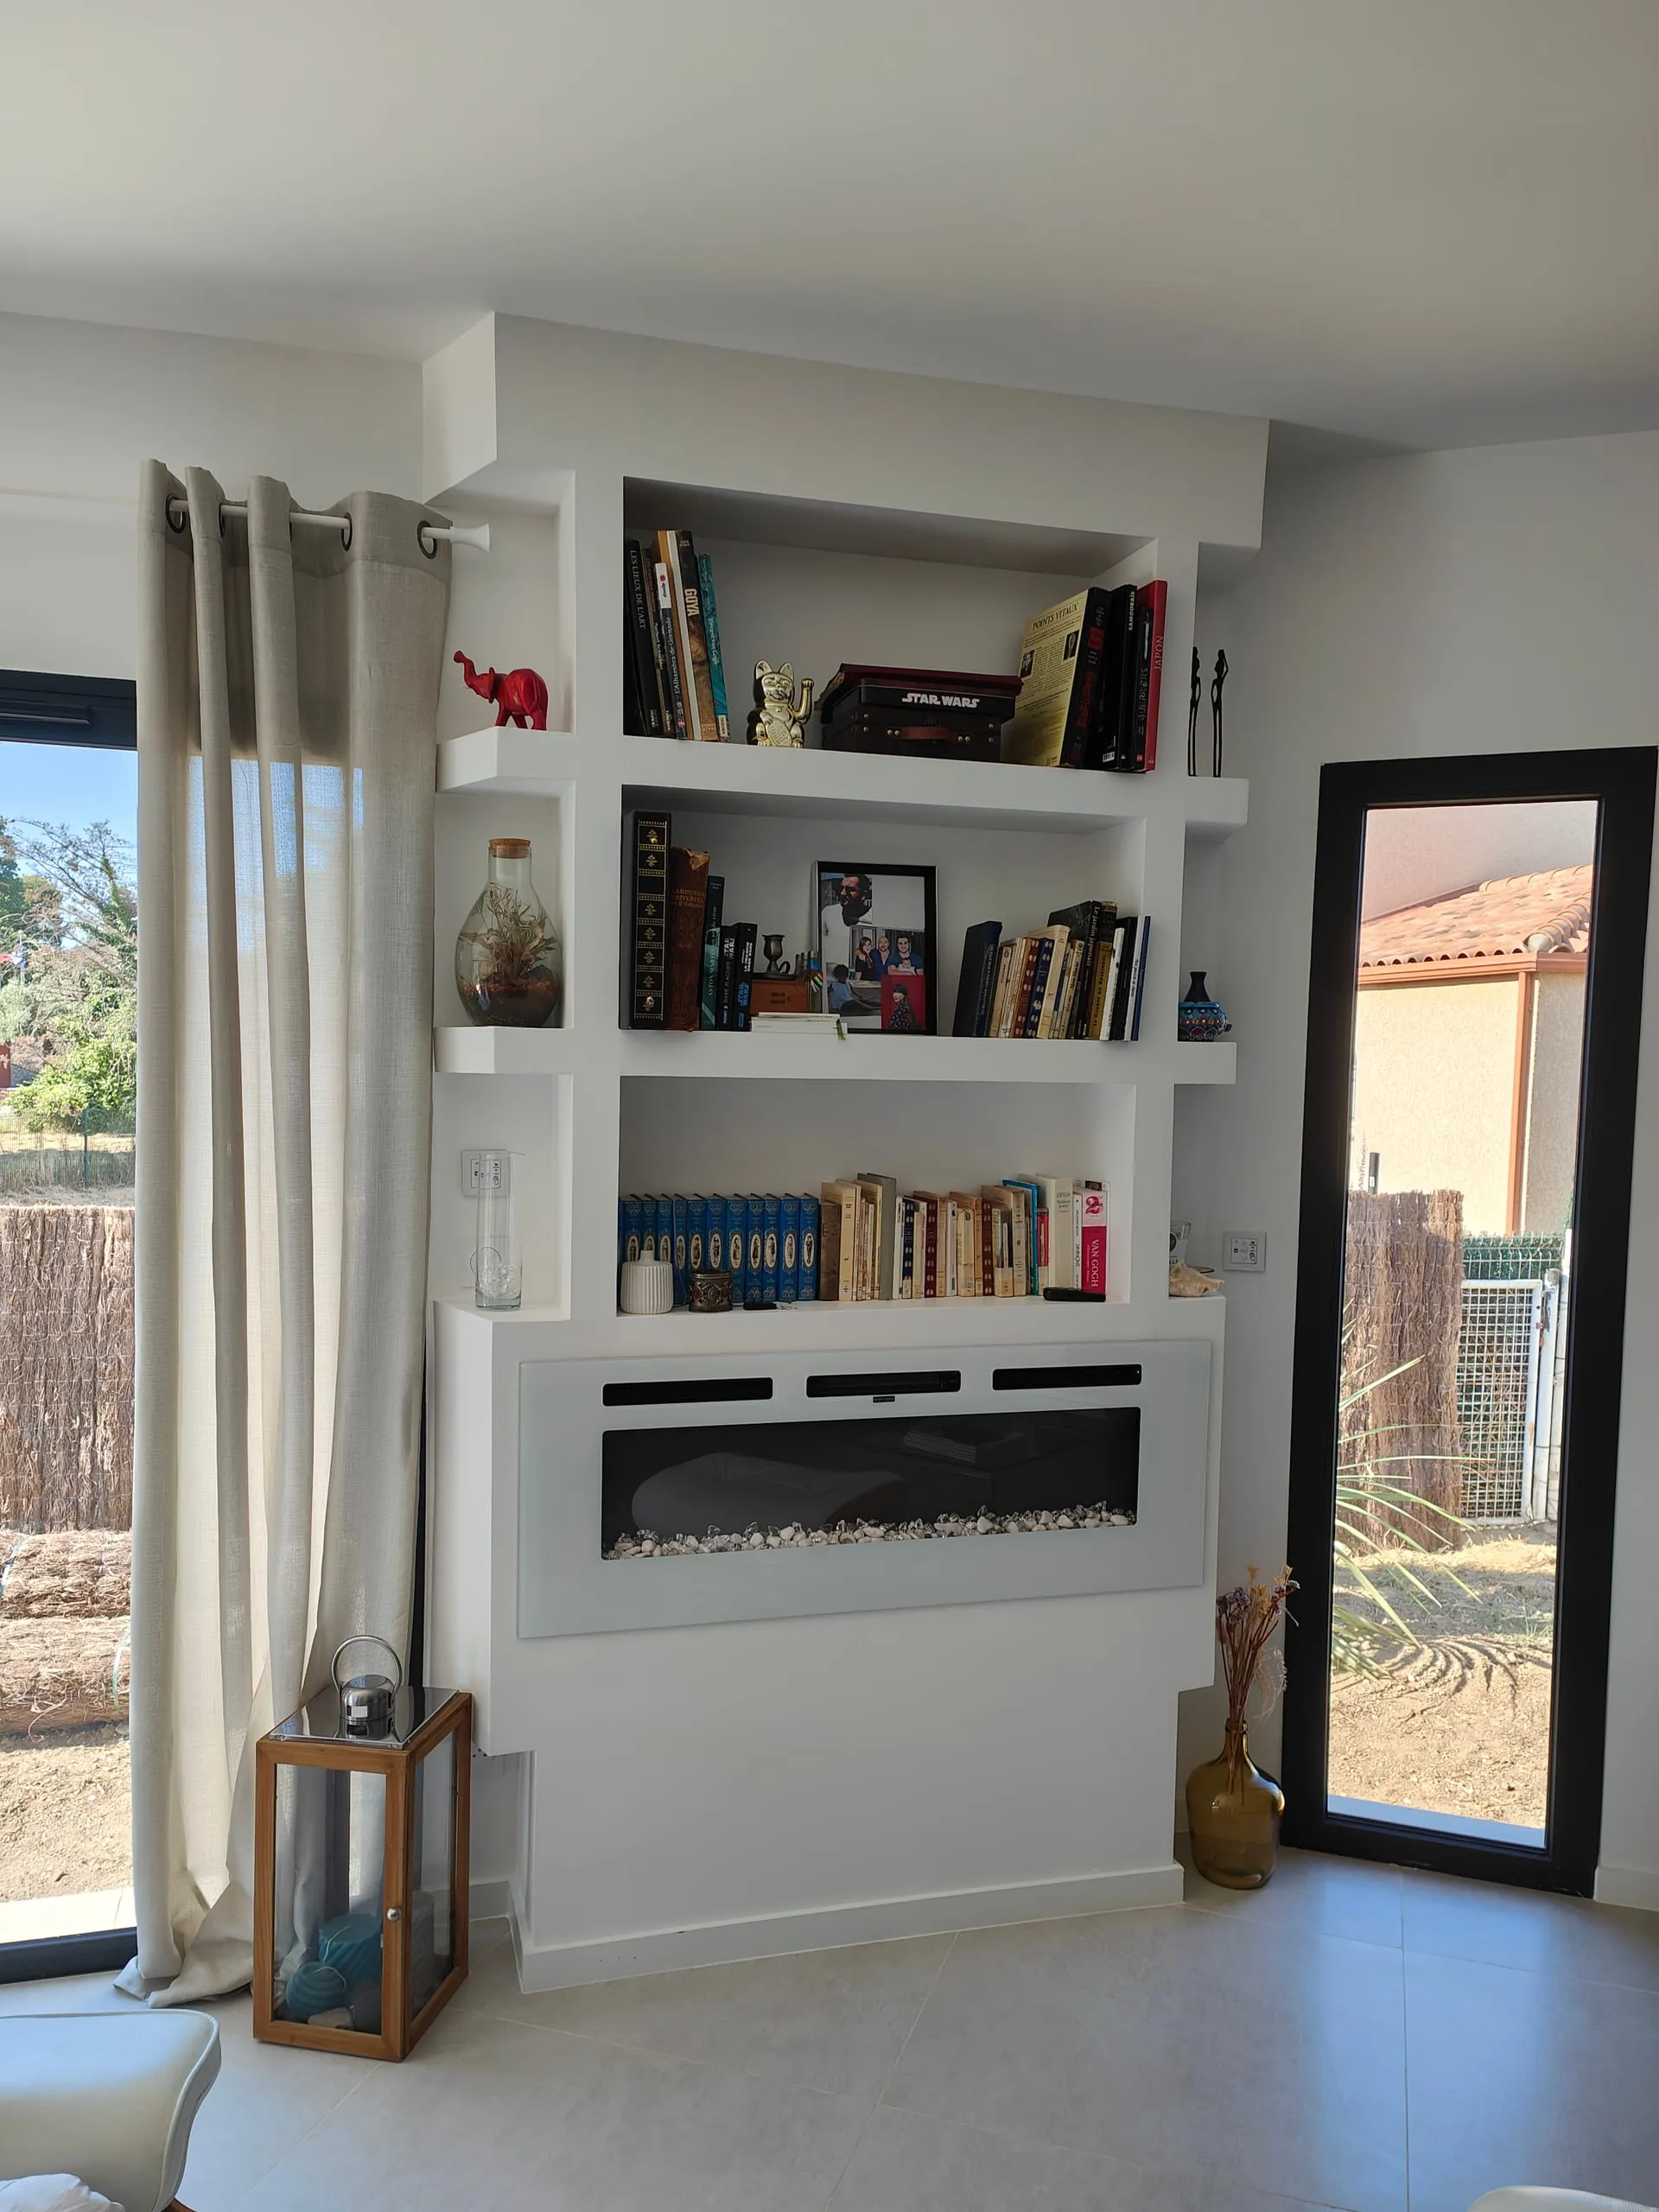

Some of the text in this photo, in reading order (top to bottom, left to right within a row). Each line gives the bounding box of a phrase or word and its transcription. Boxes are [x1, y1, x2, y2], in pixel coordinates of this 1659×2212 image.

[630, 550, 639, 564] LES
[632, 566, 642, 591] LIEUX
[635, 594, 644, 606] DE
[684, 588, 700, 616] GOYA
[1033, 614, 1054, 632] POINTS
[1054, 603, 1078, 622] VITAUX
[669, 645, 675, 655] de
[1154, 636, 1165, 671] JAPON
[901, 692, 980, 708] STAR WARS
[1086, 906, 1101, 966] Le jardin japonais
